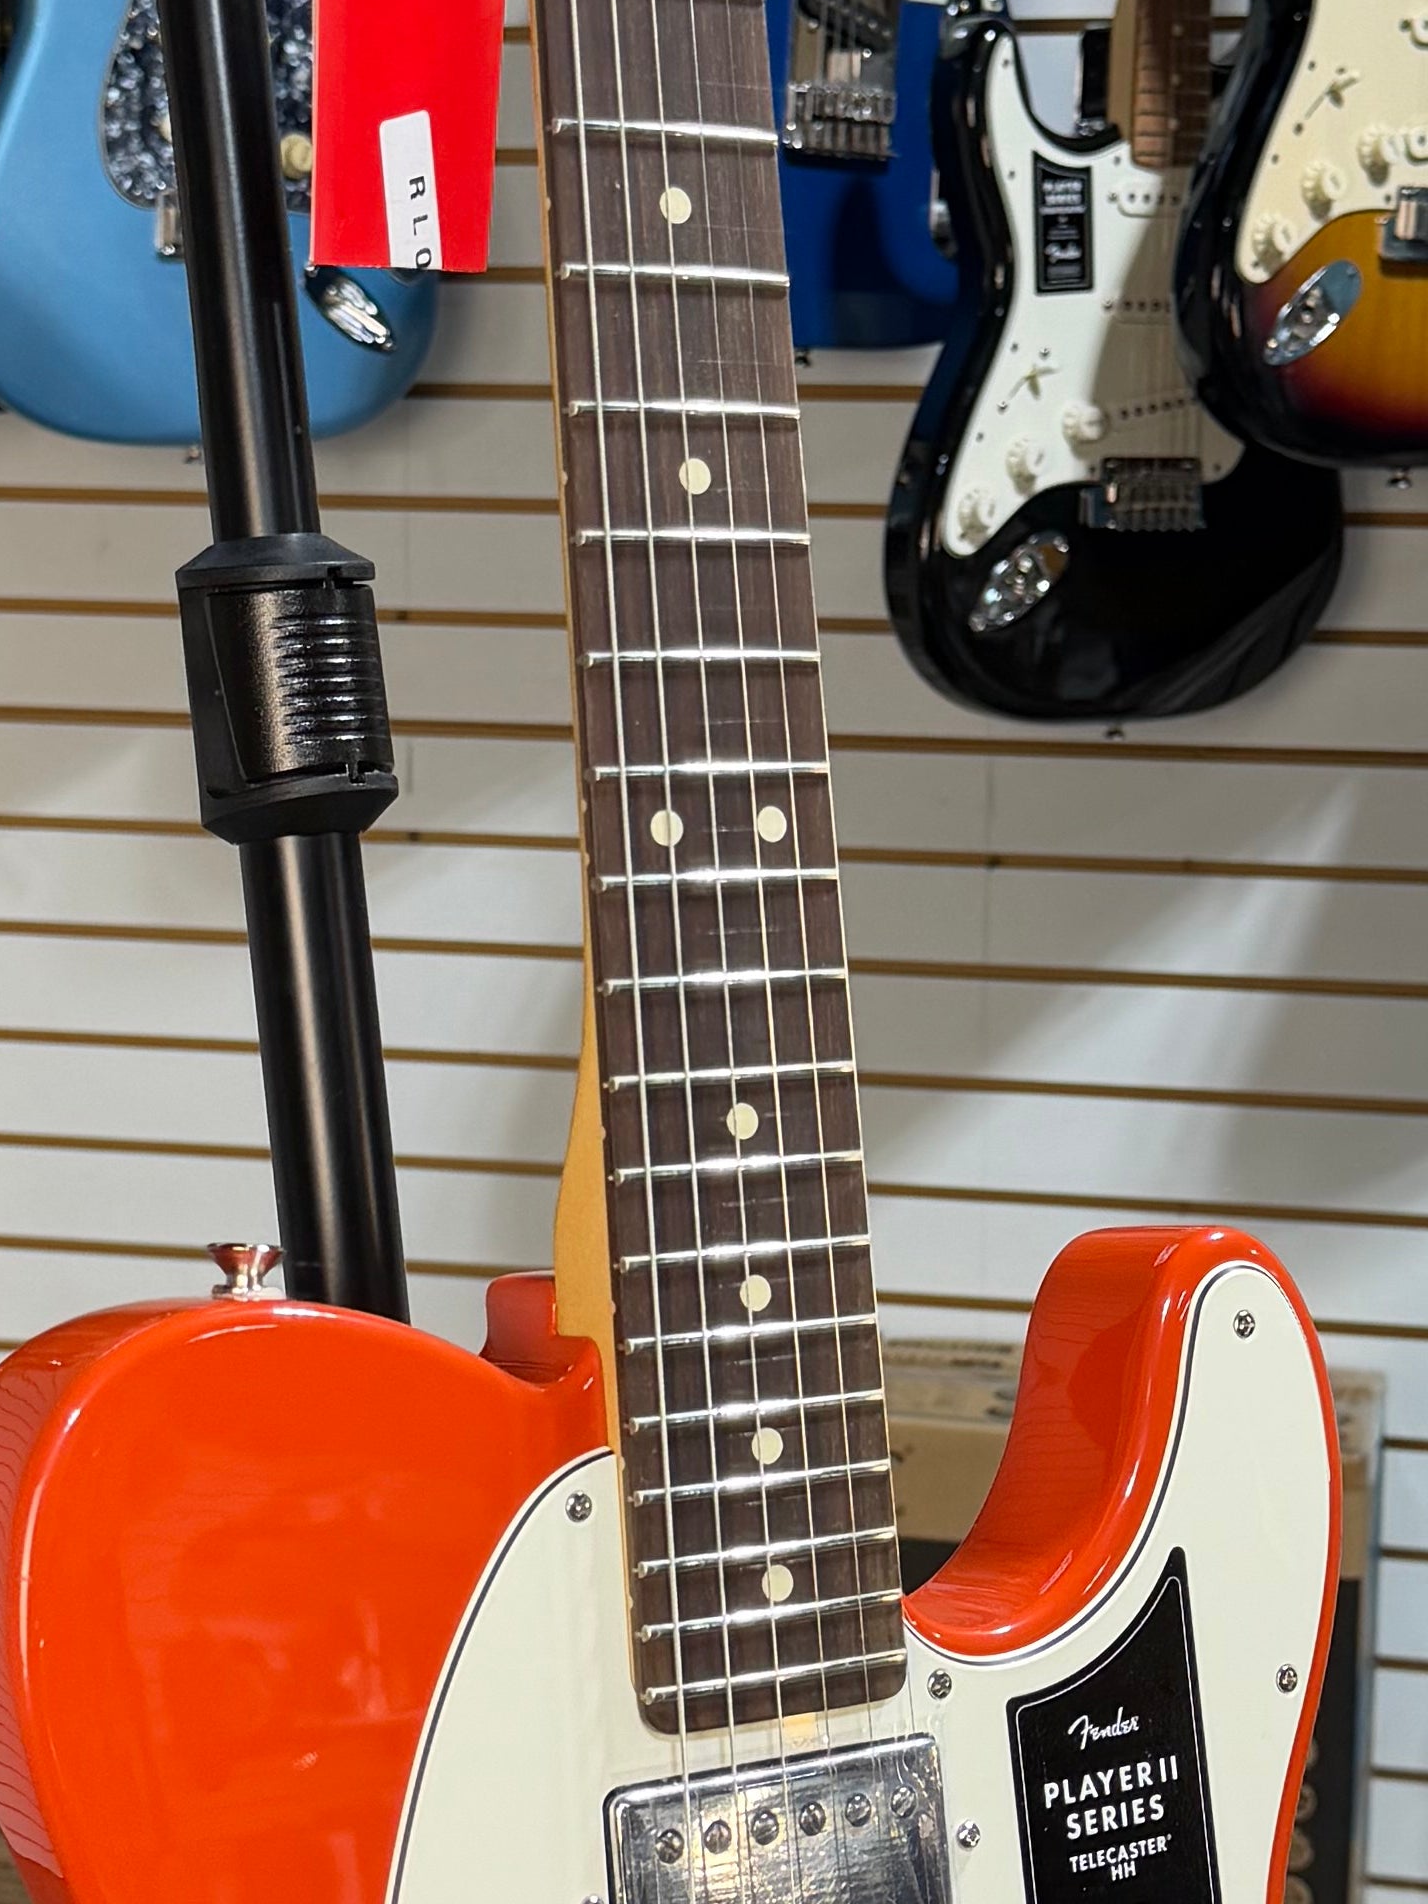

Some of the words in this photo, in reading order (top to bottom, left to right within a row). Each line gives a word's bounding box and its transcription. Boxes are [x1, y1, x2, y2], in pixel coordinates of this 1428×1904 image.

[1067, 1706, 1140, 1751] Fender
[1043, 1761, 1154, 1809] PLAYER
[1158, 1755, 1179, 1783] II
[1066, 1793, 1165, 1840] SERIES
[1110, 1860, 1137, 1882] HH
